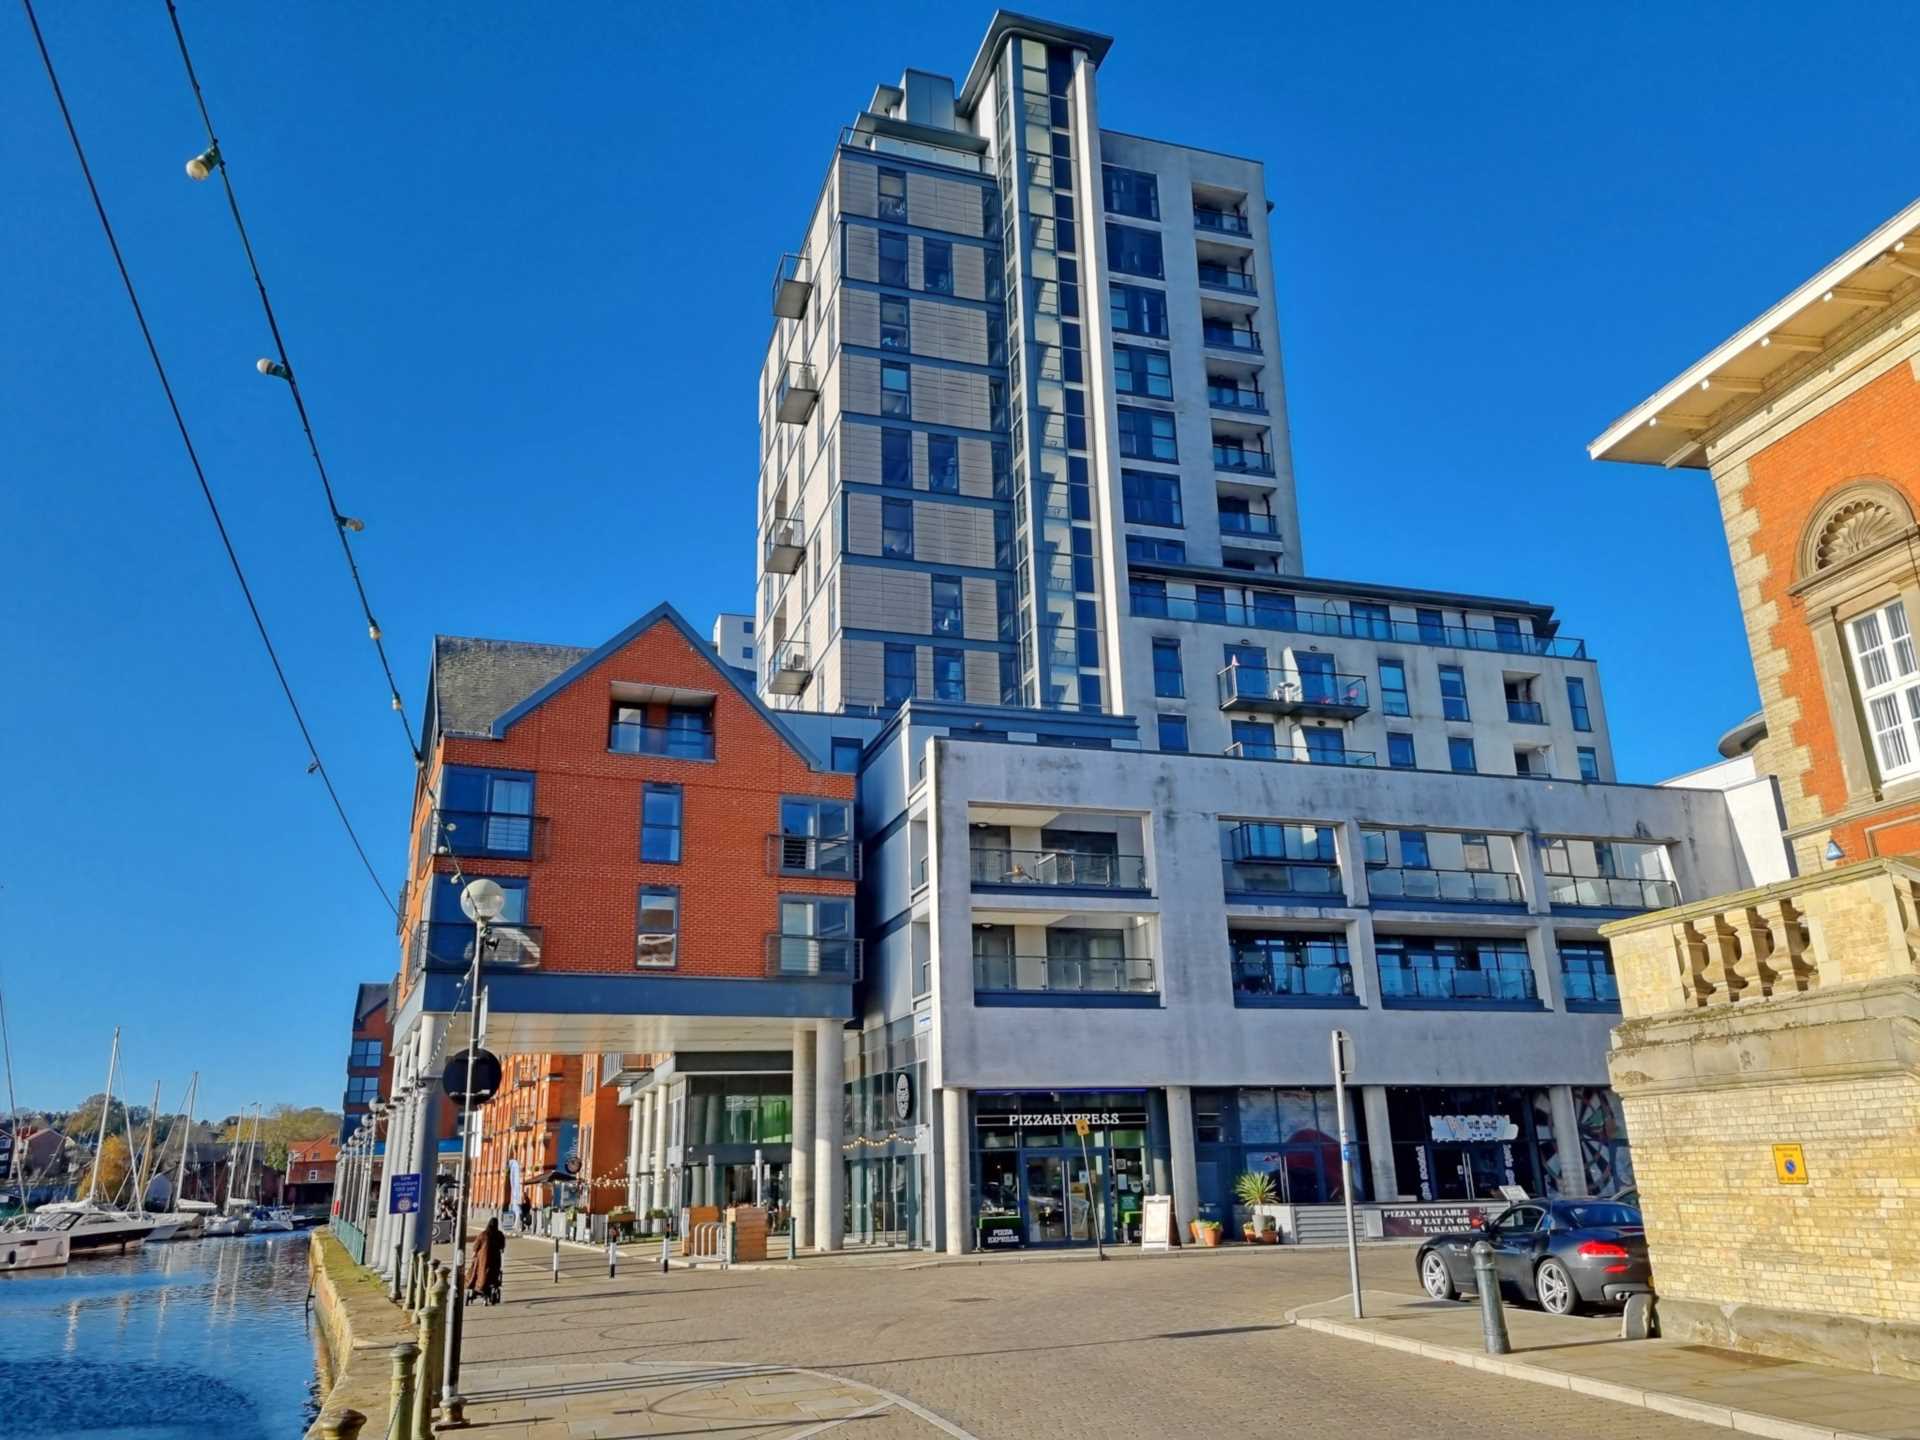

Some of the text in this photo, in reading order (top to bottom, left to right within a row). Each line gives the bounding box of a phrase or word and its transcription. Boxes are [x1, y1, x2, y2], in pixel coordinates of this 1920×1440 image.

[1008, 1112, 1120, 1126] PIZZAEXPRESS
[1383, 1208, 1470, 1218] PIZZAS AVAILABLE
[1444, 1217, 1455, 1225] IN
[1422, 1225, 1471, 1233] TAKEAWAY
